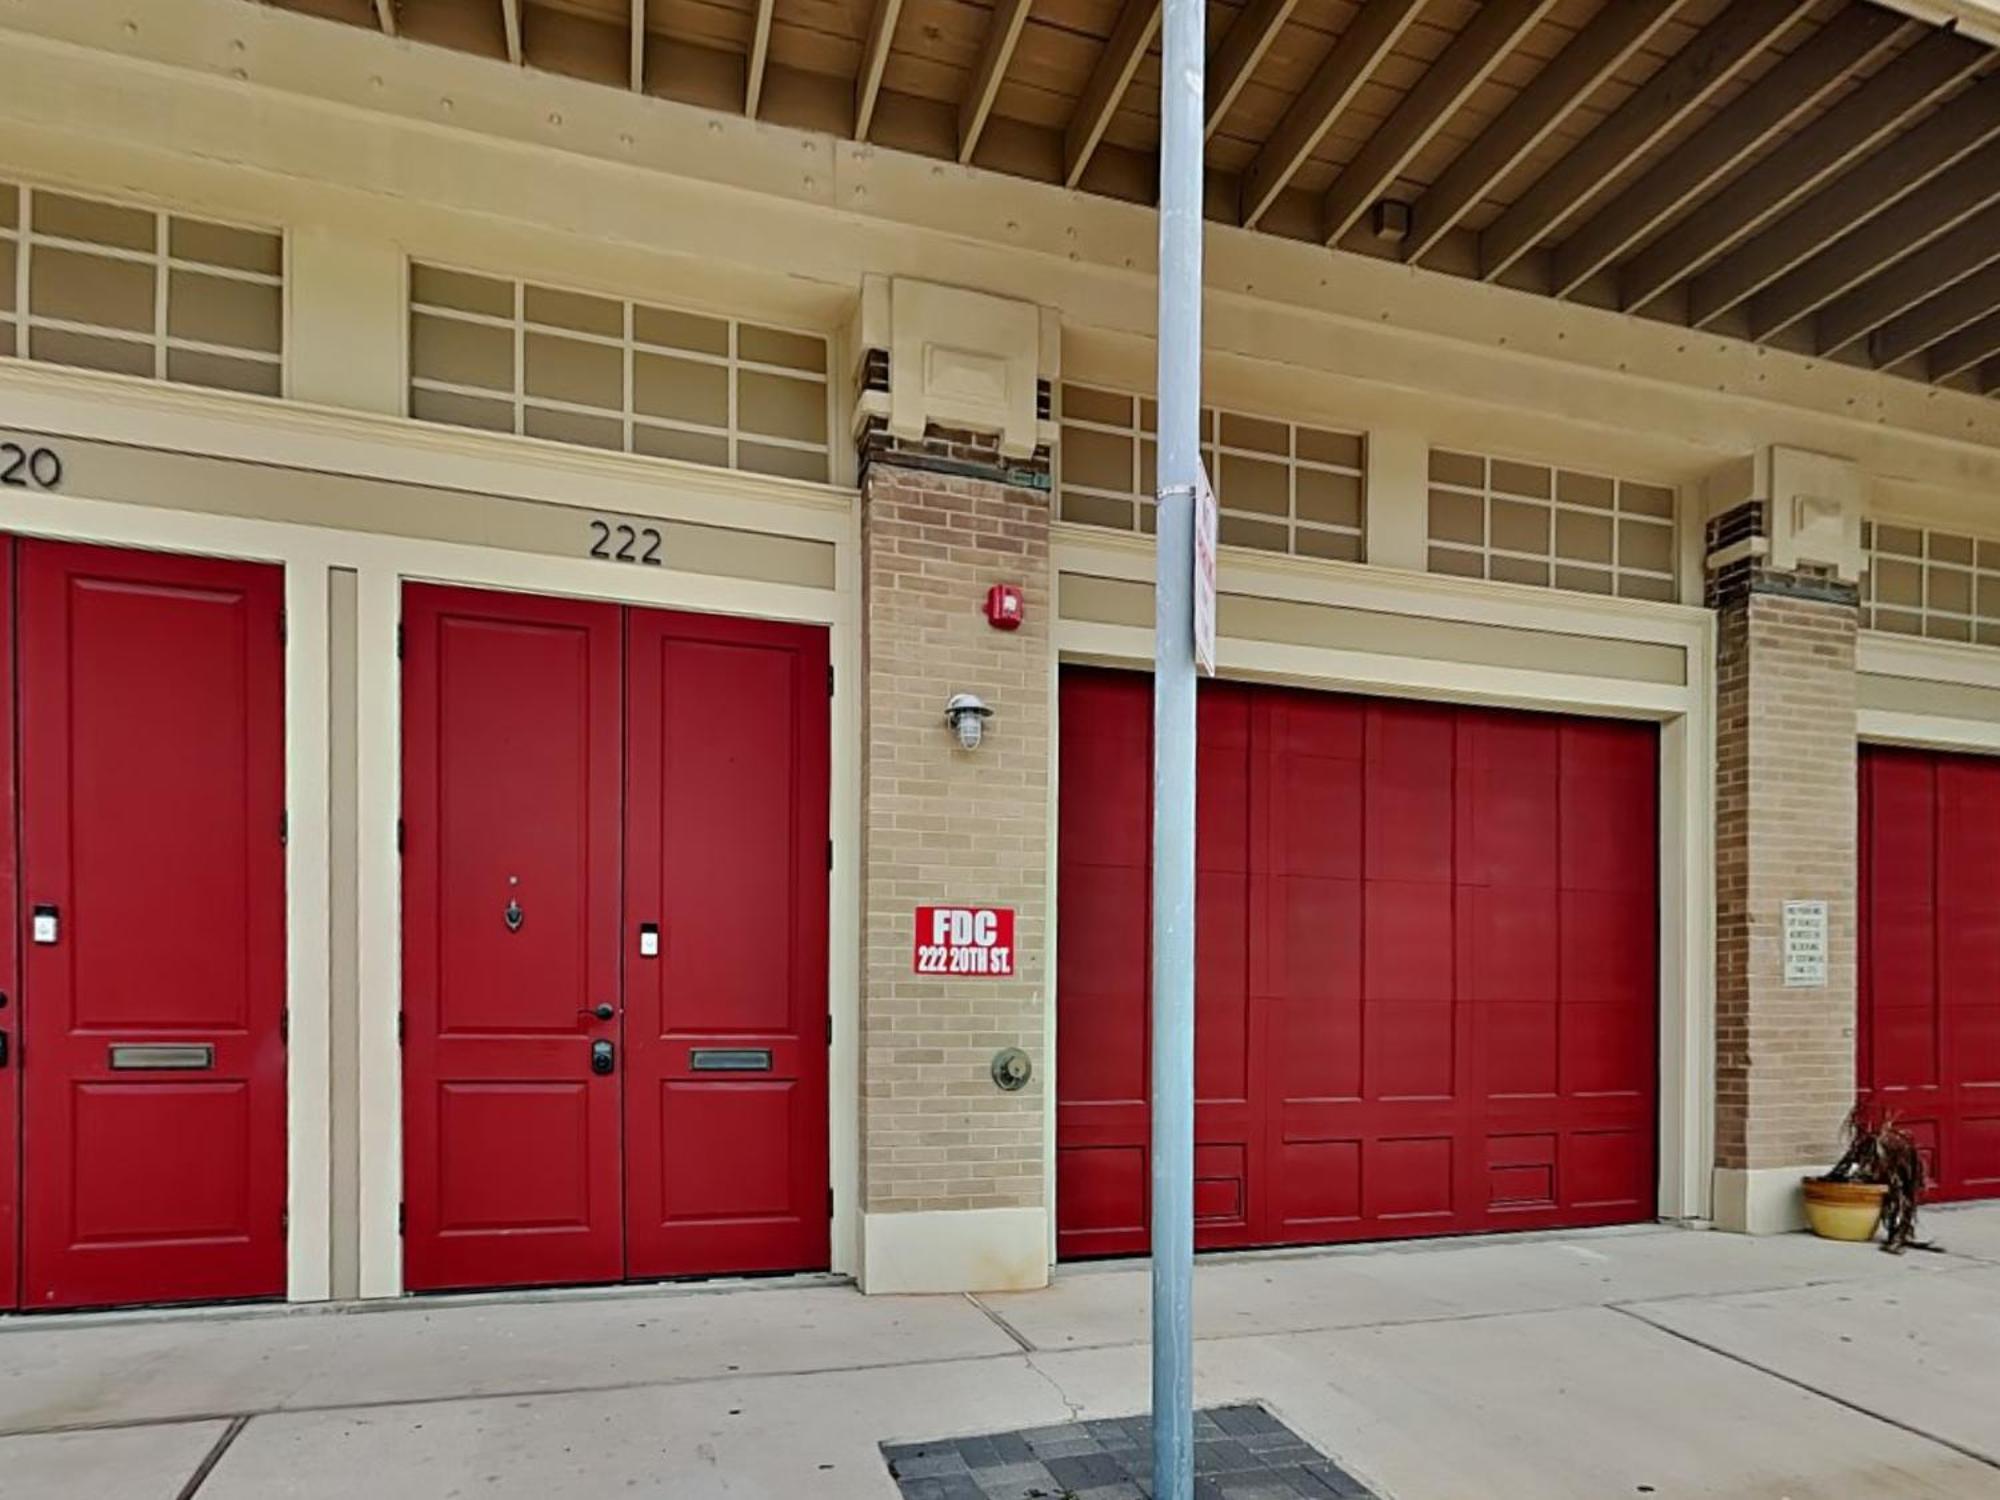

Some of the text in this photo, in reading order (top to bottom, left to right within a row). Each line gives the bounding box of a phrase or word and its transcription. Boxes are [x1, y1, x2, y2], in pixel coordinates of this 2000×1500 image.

[0, 443, 62, 487] 20
[591, 520, 661, 565] 222
[933, 909, 997, 946] FDC
[918, 946, 1011, 973] 222 20TH ST.
